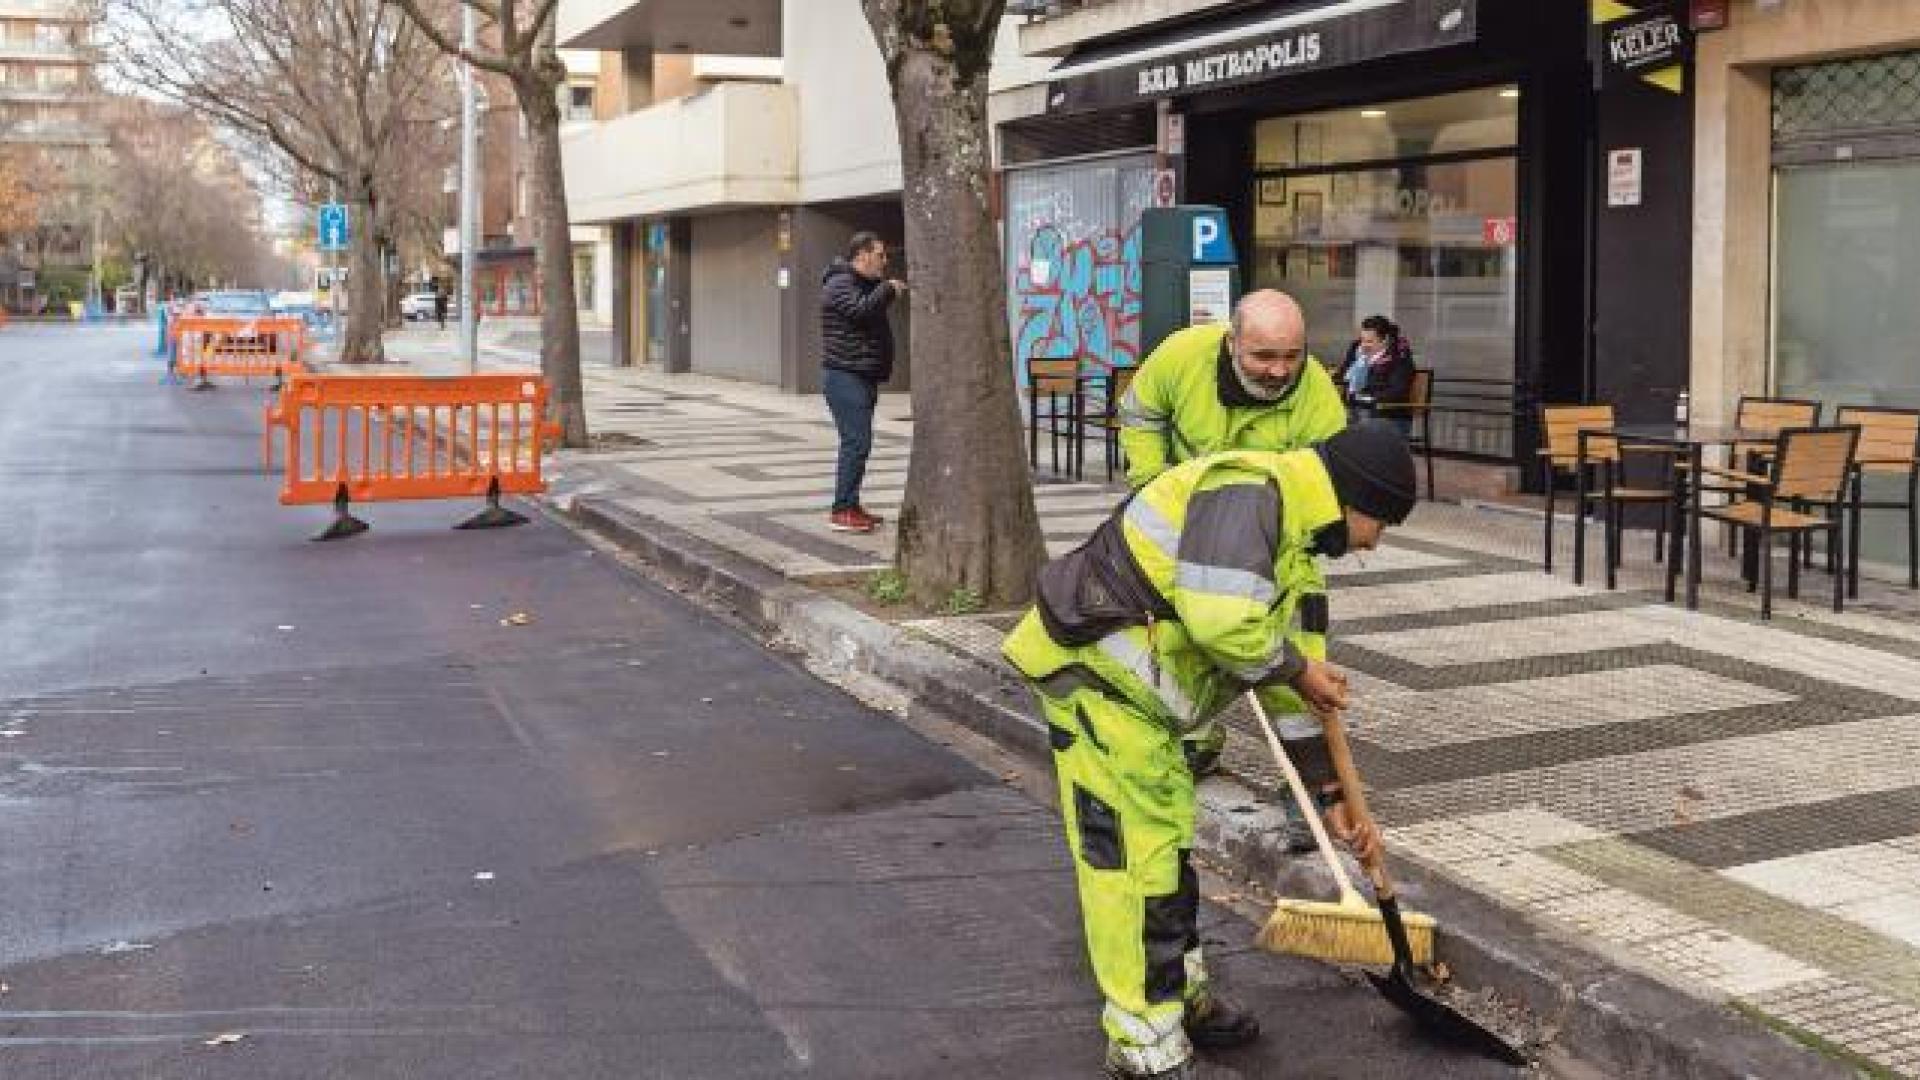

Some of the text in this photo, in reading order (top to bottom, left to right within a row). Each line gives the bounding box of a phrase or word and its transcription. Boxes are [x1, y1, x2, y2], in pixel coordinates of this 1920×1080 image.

[1186, 33, 1320, 85] METROPOLIS
[1610, 19, 1681, 62] KELER
[1193, 216, 1217, 260] P
